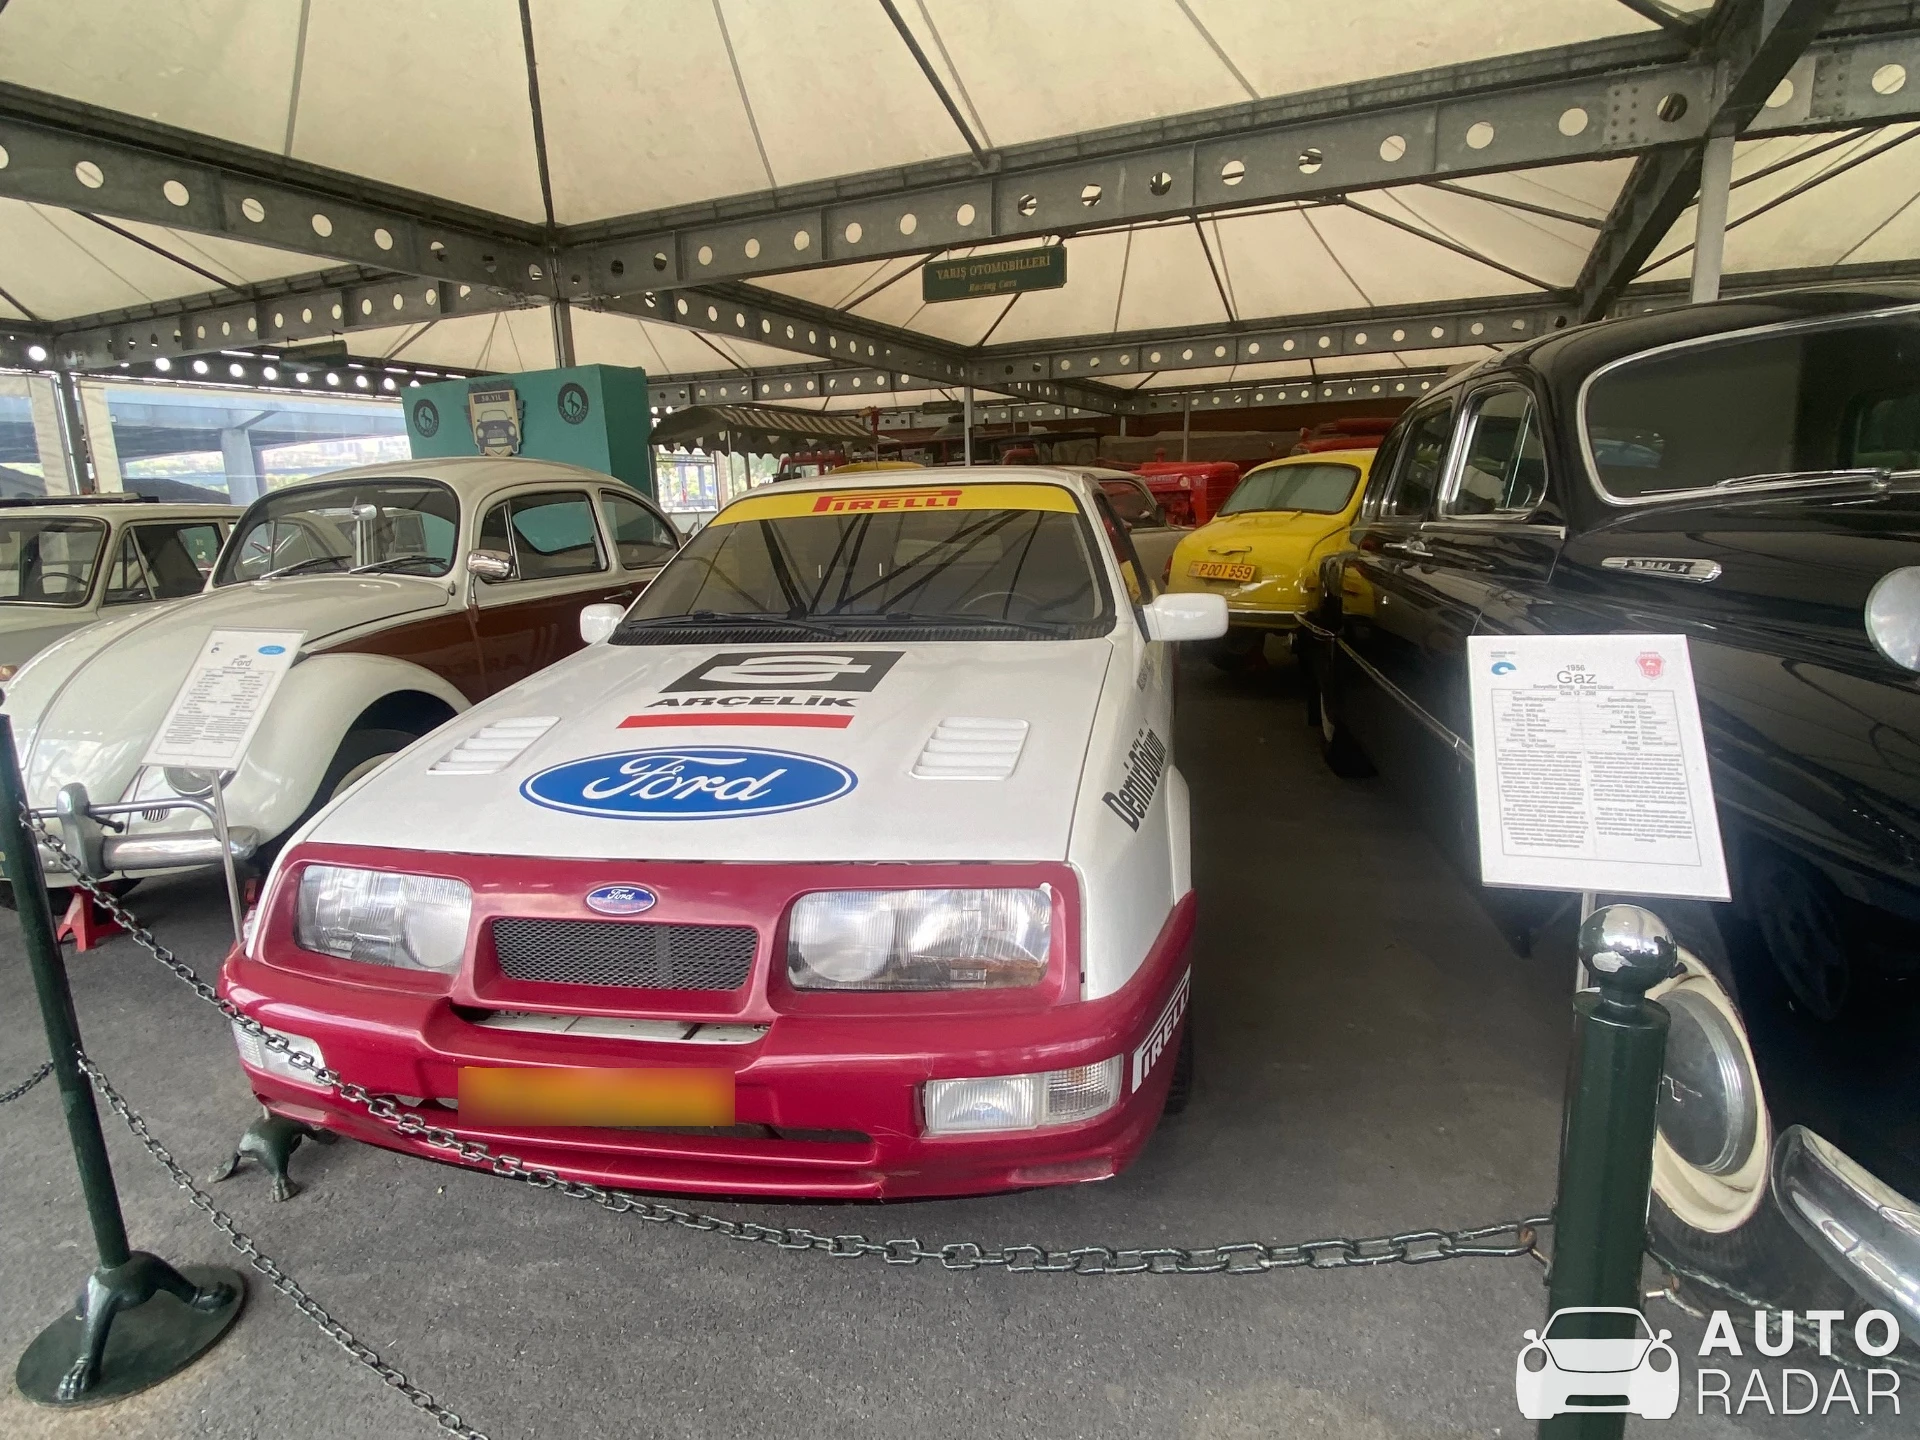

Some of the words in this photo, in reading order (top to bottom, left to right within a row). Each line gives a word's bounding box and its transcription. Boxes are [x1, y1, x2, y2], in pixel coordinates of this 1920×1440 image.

[936, 267, 967, 281] YARIŞ
[969, 254, 1051, 276] OTOMOBİLLERİ
[812, 490, 963, 512] PIRELLI
[230, 658, 253, 667] Ford
[1556, 670, 1598, 685] Gaz
[644, 694, 860, 709] ARÇELİK
[581, 756, 787, 802] Ford
[607, 888, 635, 900] Ford
[1131, 963, 1192, 1094] PIRELLI
